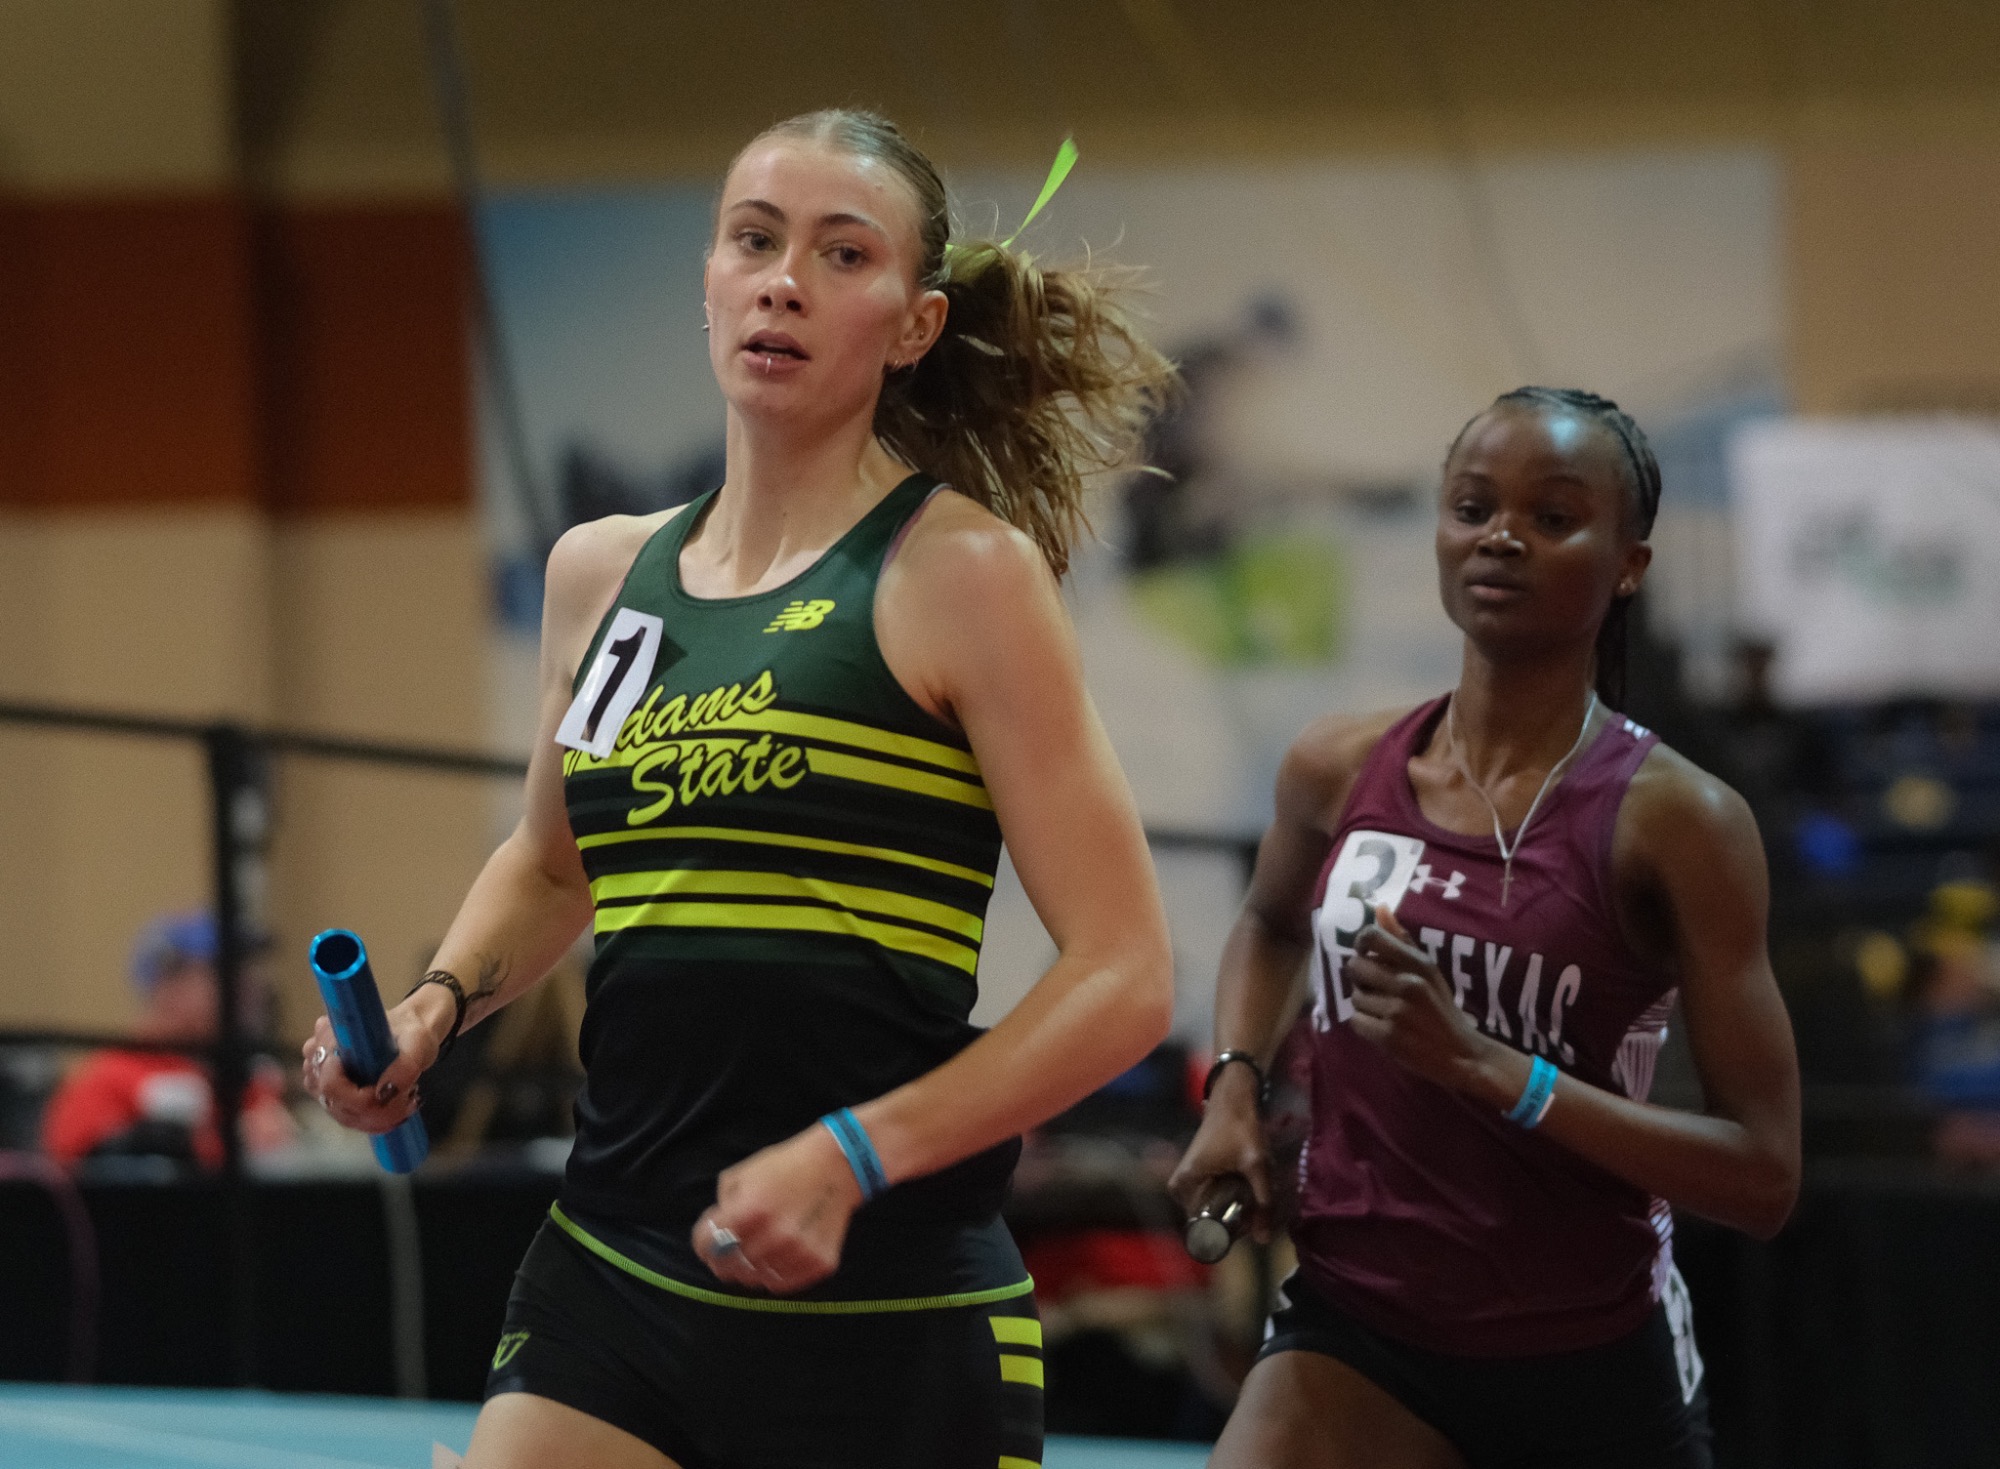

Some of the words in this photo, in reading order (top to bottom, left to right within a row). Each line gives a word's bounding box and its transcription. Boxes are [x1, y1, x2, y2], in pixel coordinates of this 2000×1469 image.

[580, 626, 647, 742] 1
[580, 670, 777, 763] dams
[627, 734, 805, 826] State
[1335, 839, 1397, 949] 3
